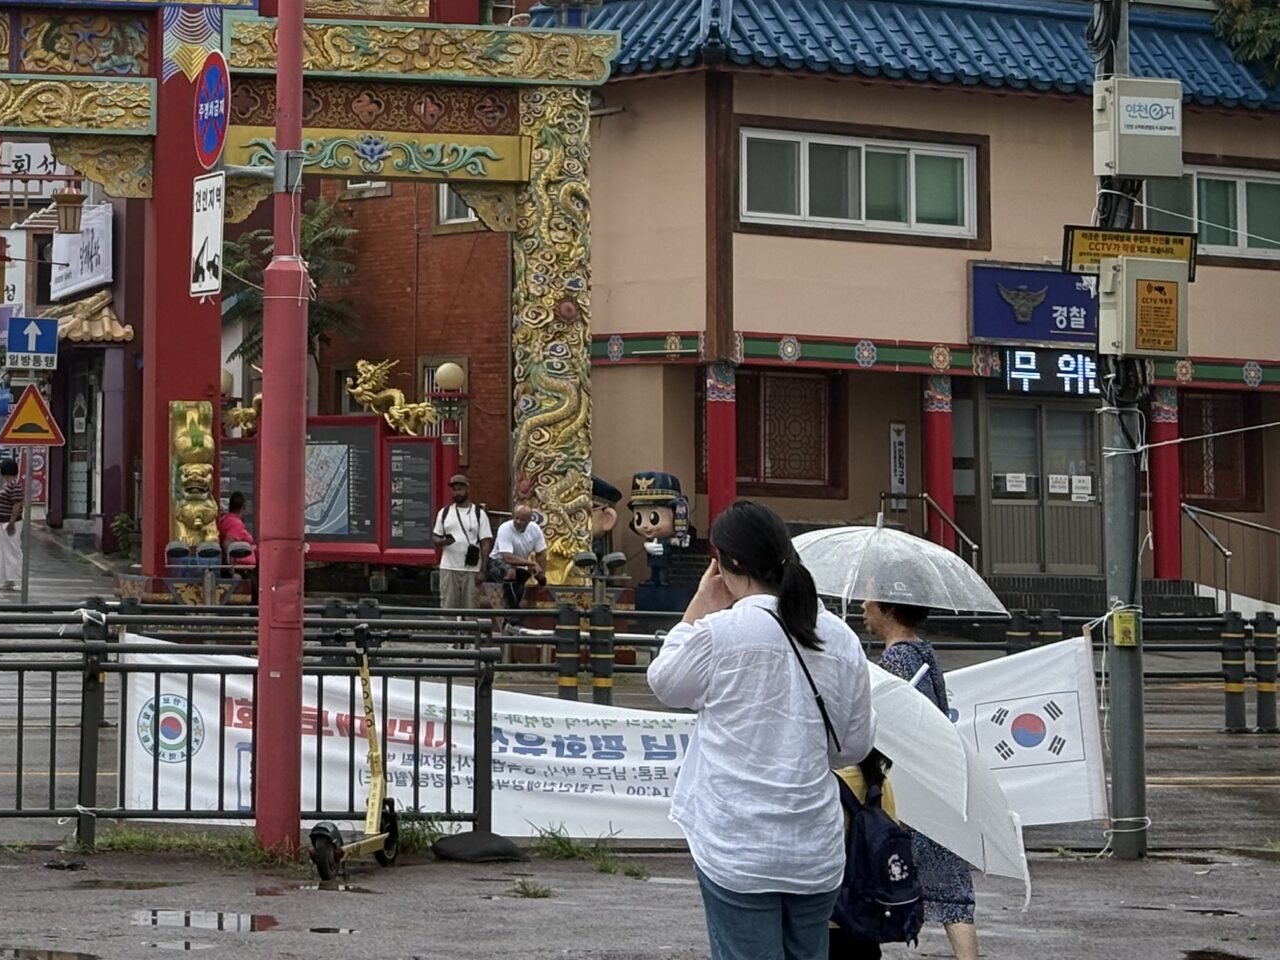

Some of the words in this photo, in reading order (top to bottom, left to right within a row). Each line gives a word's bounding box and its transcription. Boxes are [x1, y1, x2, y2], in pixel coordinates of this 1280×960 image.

[198, 98, 224, 121] 주정차금지
[195, 189, 222, 213] 견인지역
[1052, 305, 1087, 330] 경찰
[8, 354, 55, 368] 일방통행
